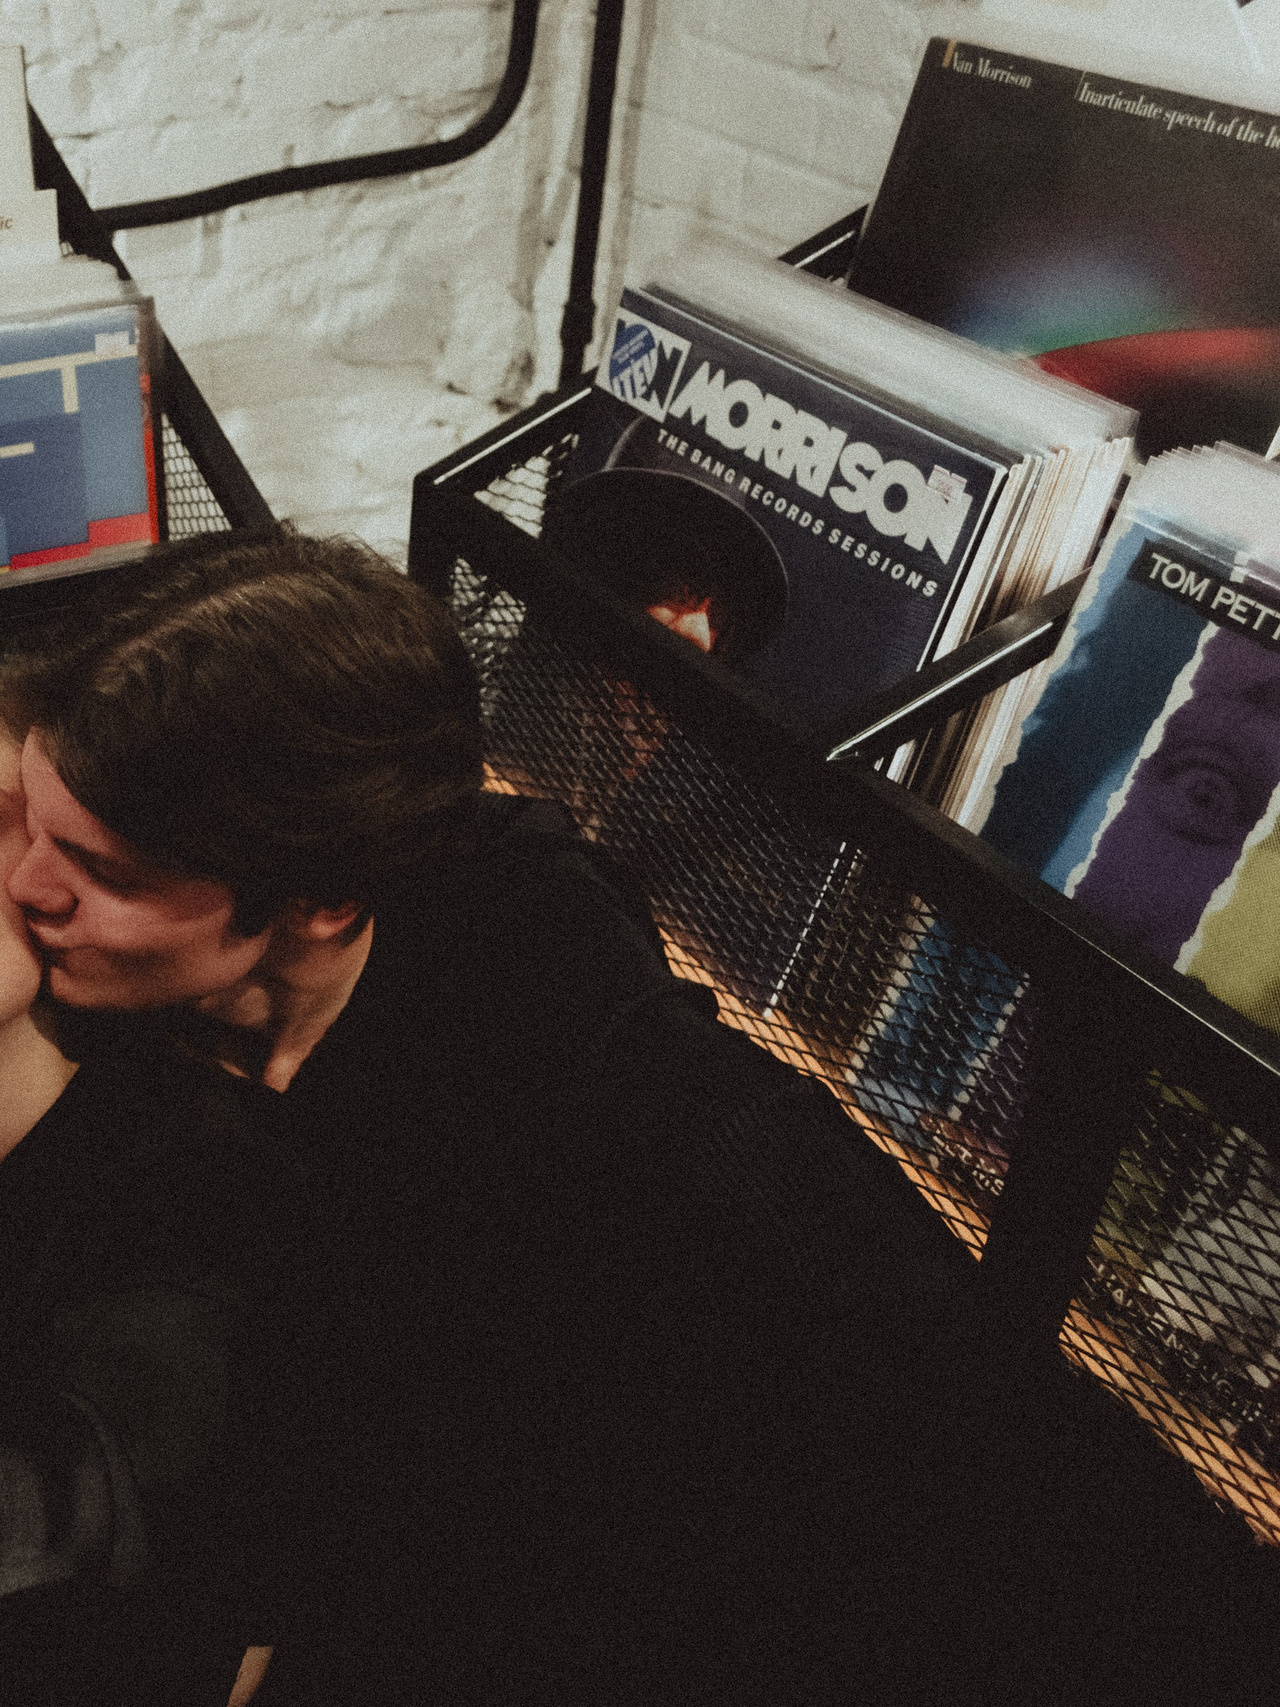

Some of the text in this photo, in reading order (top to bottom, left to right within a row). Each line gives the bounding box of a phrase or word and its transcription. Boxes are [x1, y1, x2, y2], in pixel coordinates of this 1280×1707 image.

[951, 51, 1033, 89] Van Morrison
[1077, 82, 1164, 121] Inarticulate
[1162, 109, 1217, 134] speech
[1215, 116, 1240, 137] of
[1235, 120, 1265, 143] the
[668, 360, 974, 566] MORRISON
[657, 429, 940, 598] THE BANG RECORDS SESSIONS
[1149, 552, 1211, 603] TOM
